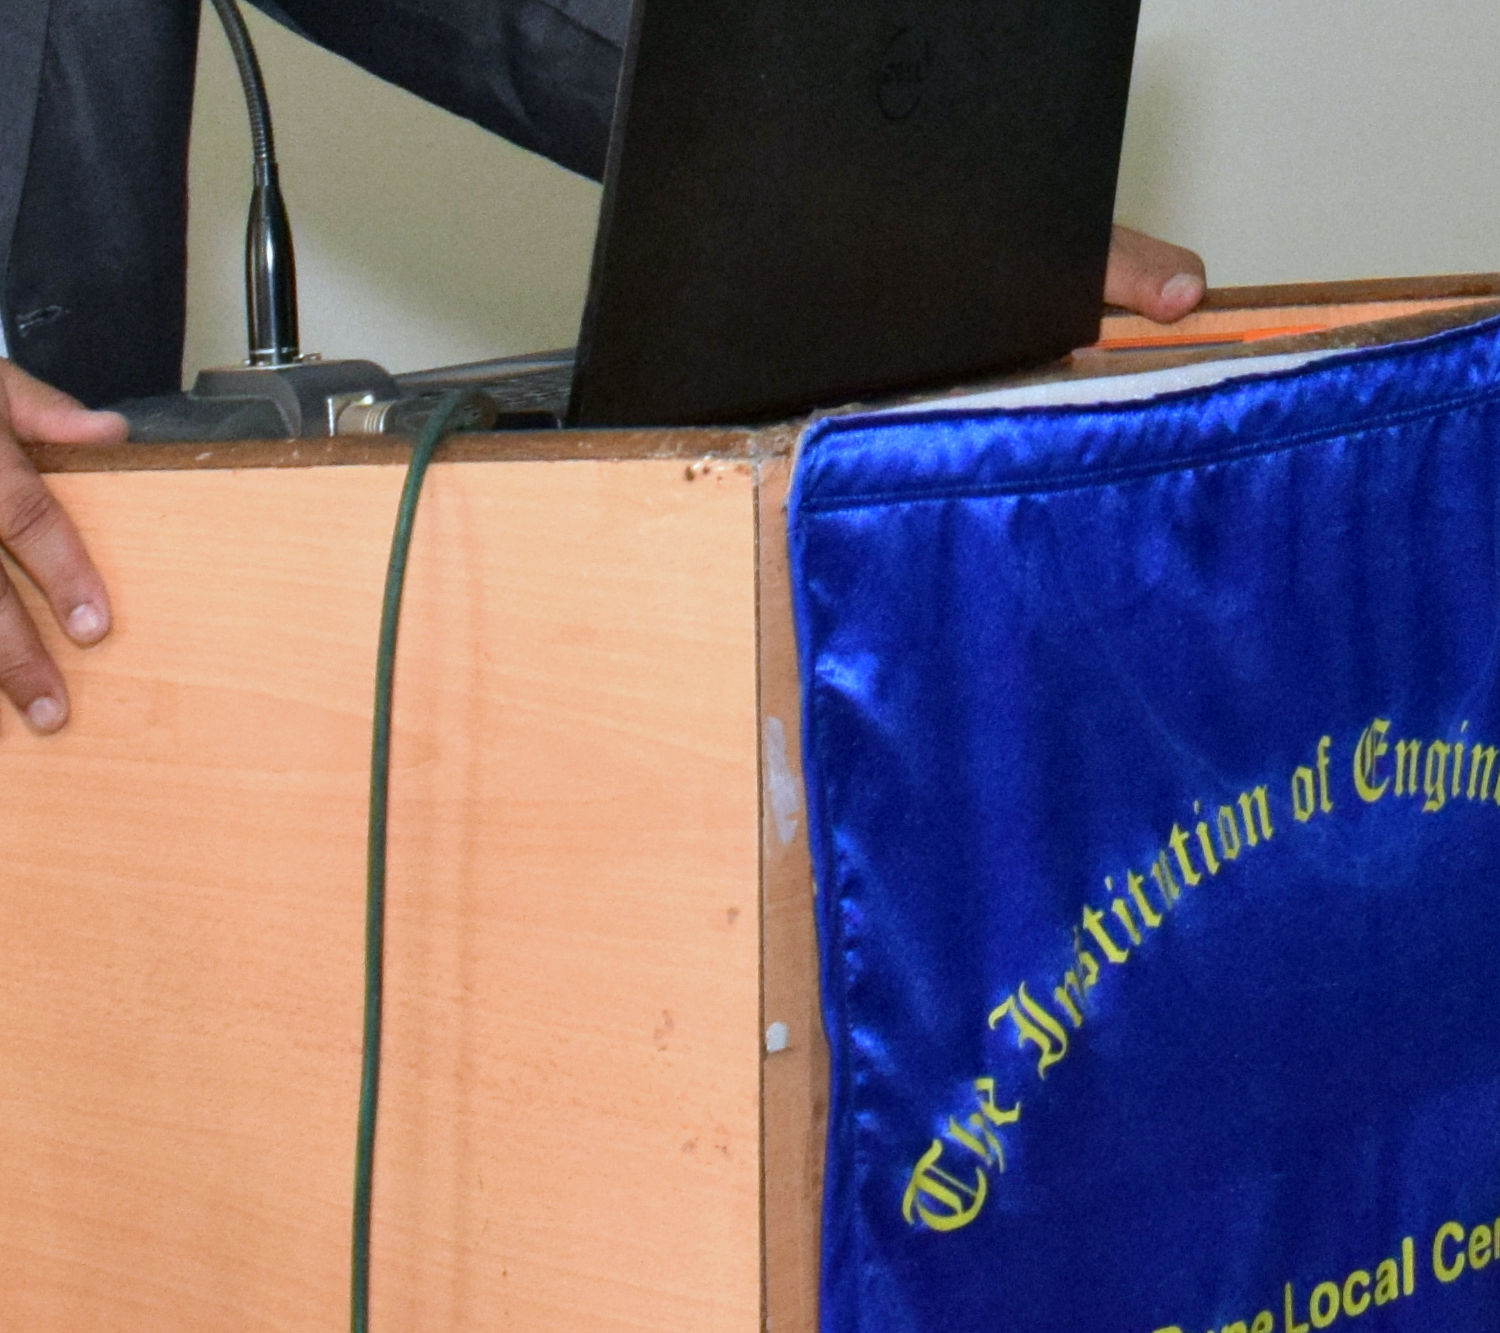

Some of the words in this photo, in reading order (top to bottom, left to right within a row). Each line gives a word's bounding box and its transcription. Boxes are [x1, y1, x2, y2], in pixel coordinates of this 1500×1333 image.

[900, 1074, 1021, 1231] The
[988, 782, 1273, 1080] Institution
[1290, 735, 1334, 823] of
[1285, 1236, 1415, 1333] Local
